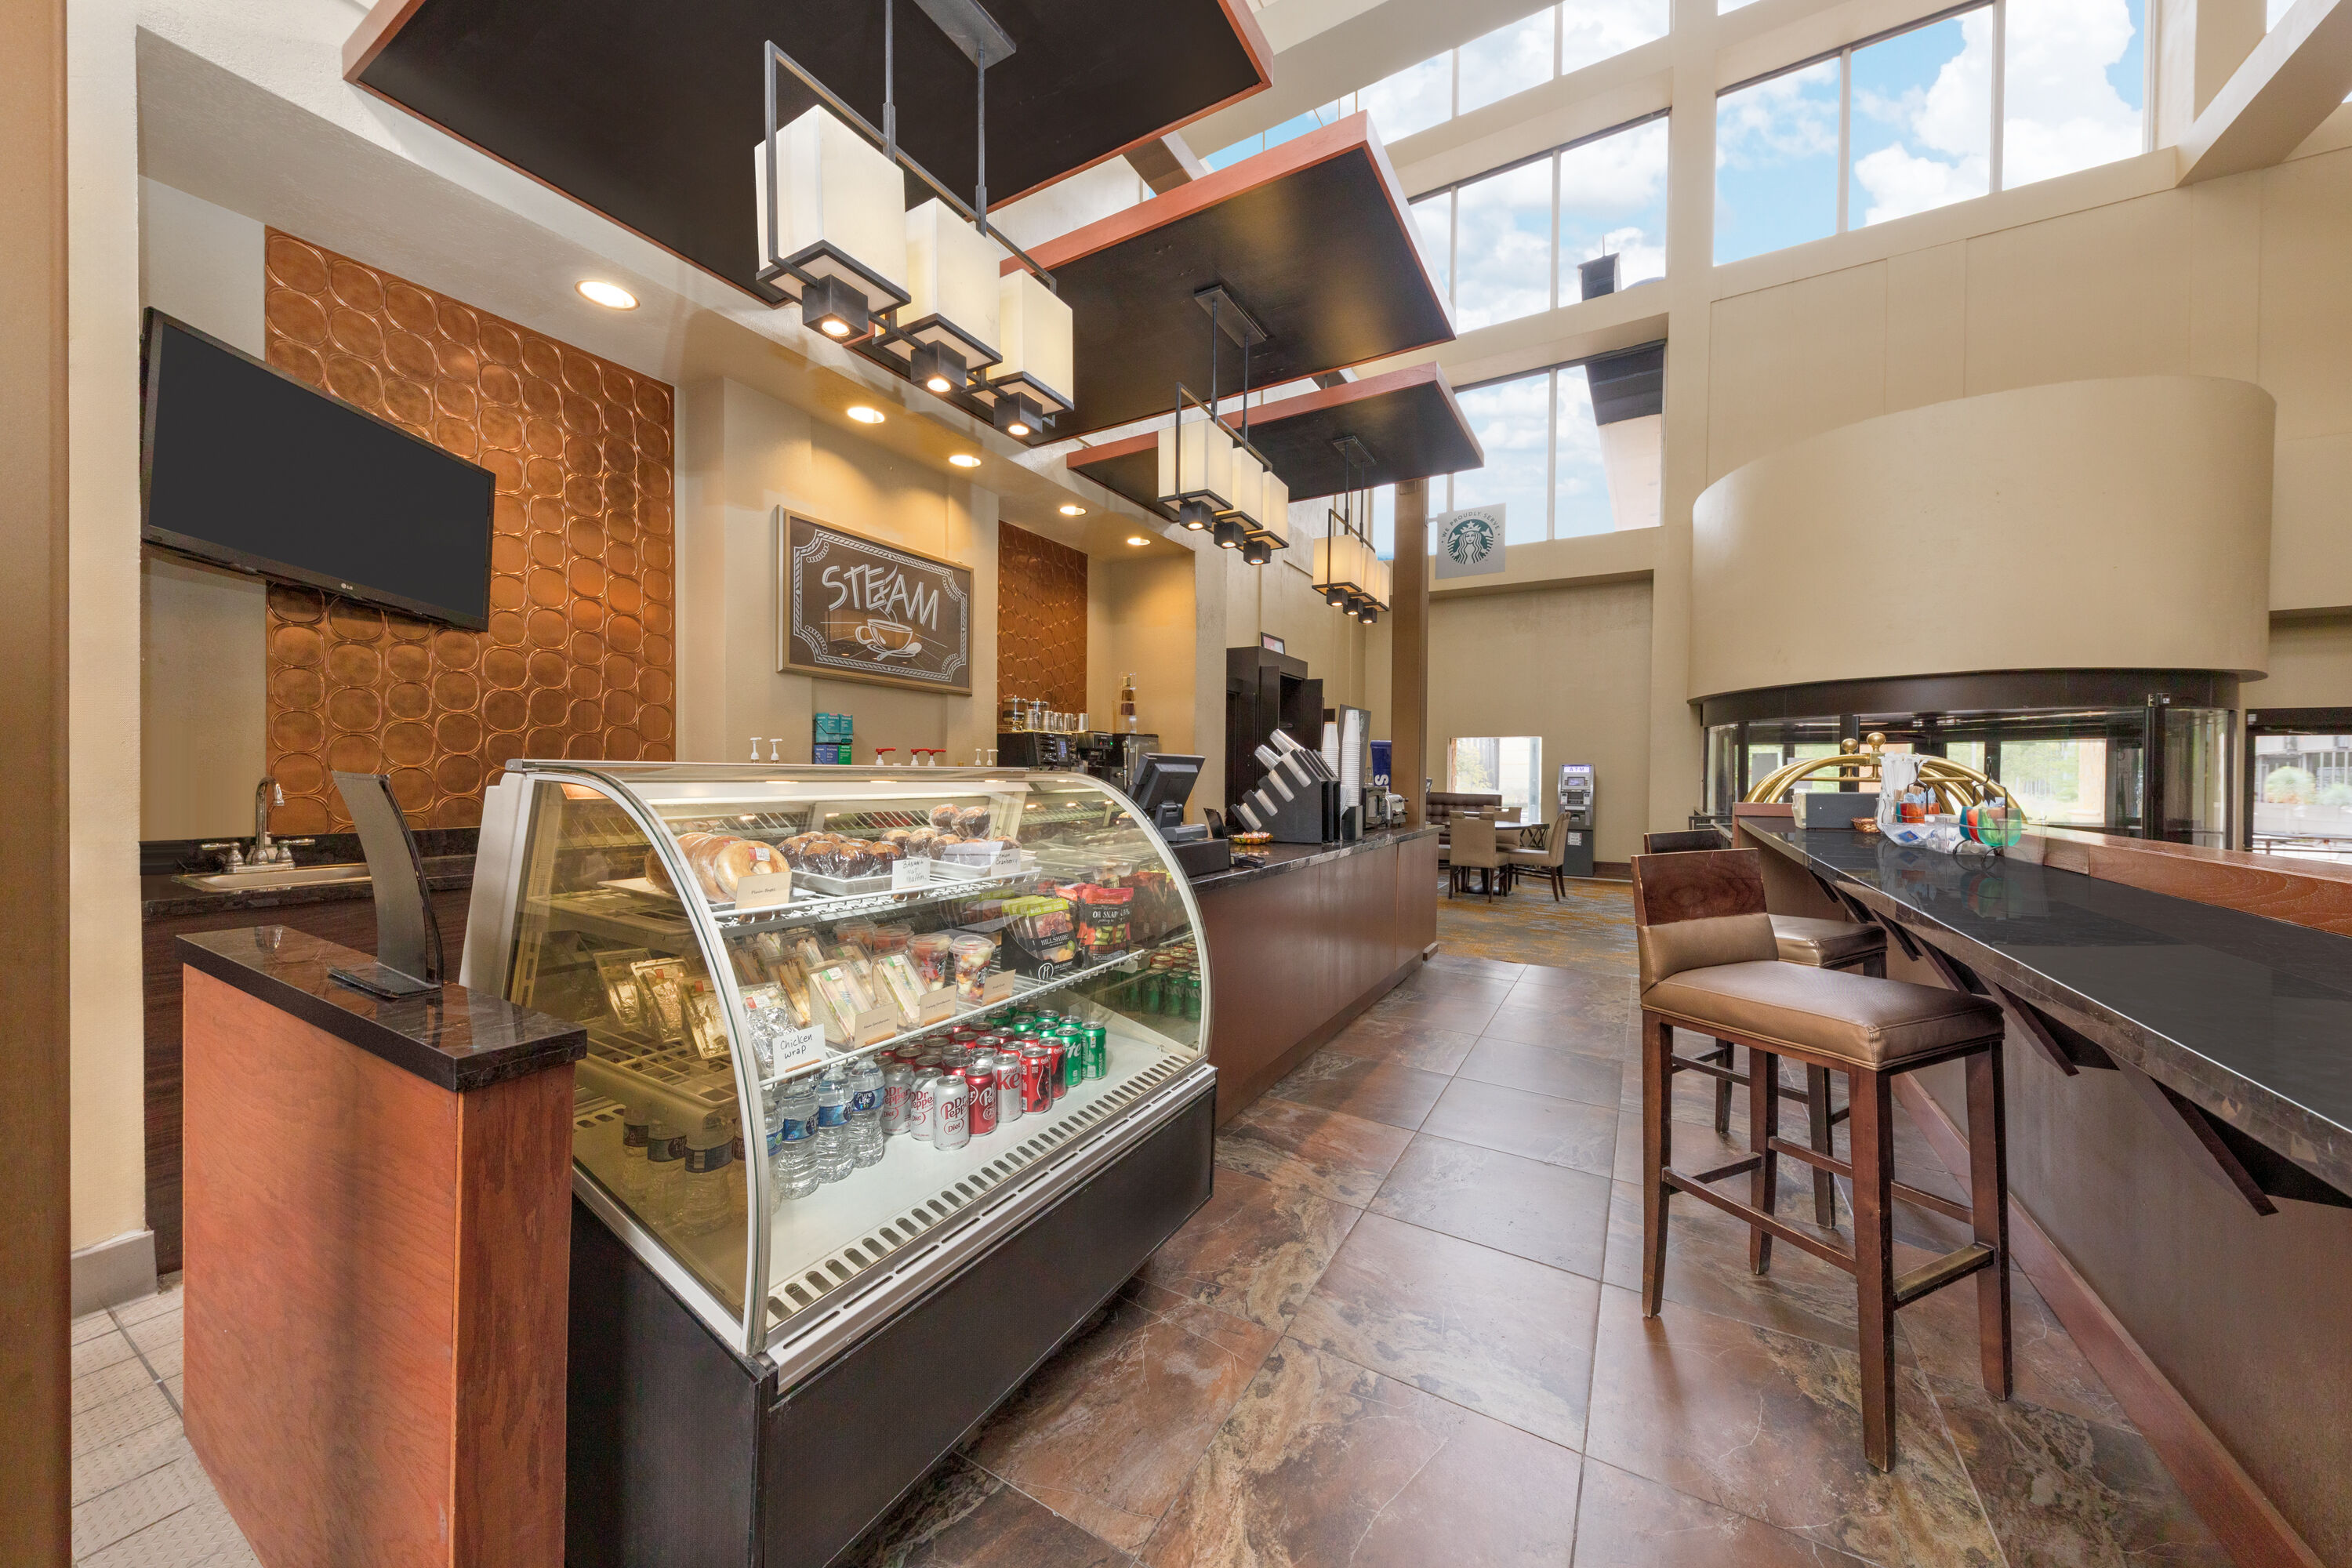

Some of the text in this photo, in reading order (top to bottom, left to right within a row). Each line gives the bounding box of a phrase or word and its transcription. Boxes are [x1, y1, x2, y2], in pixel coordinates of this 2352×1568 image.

[1442, 511, 1501, 538] WE PROUDLY SERVE
[822, 564, 939, 632] STEAM
[1040, 934, 1069, 946] HILLSHIRE
[780, 1034, 812, 1050] Chicken
[785, 1045, 807, 1058] wrap
[997, 1069, 1021, 1091] ke
[889, 1087, 902, 1097] Dr
[916, 1091, 929, 1101] Dr
[954, 1095, 966, 1109] Dr
[948, 1123, 960, 1133] Diet
